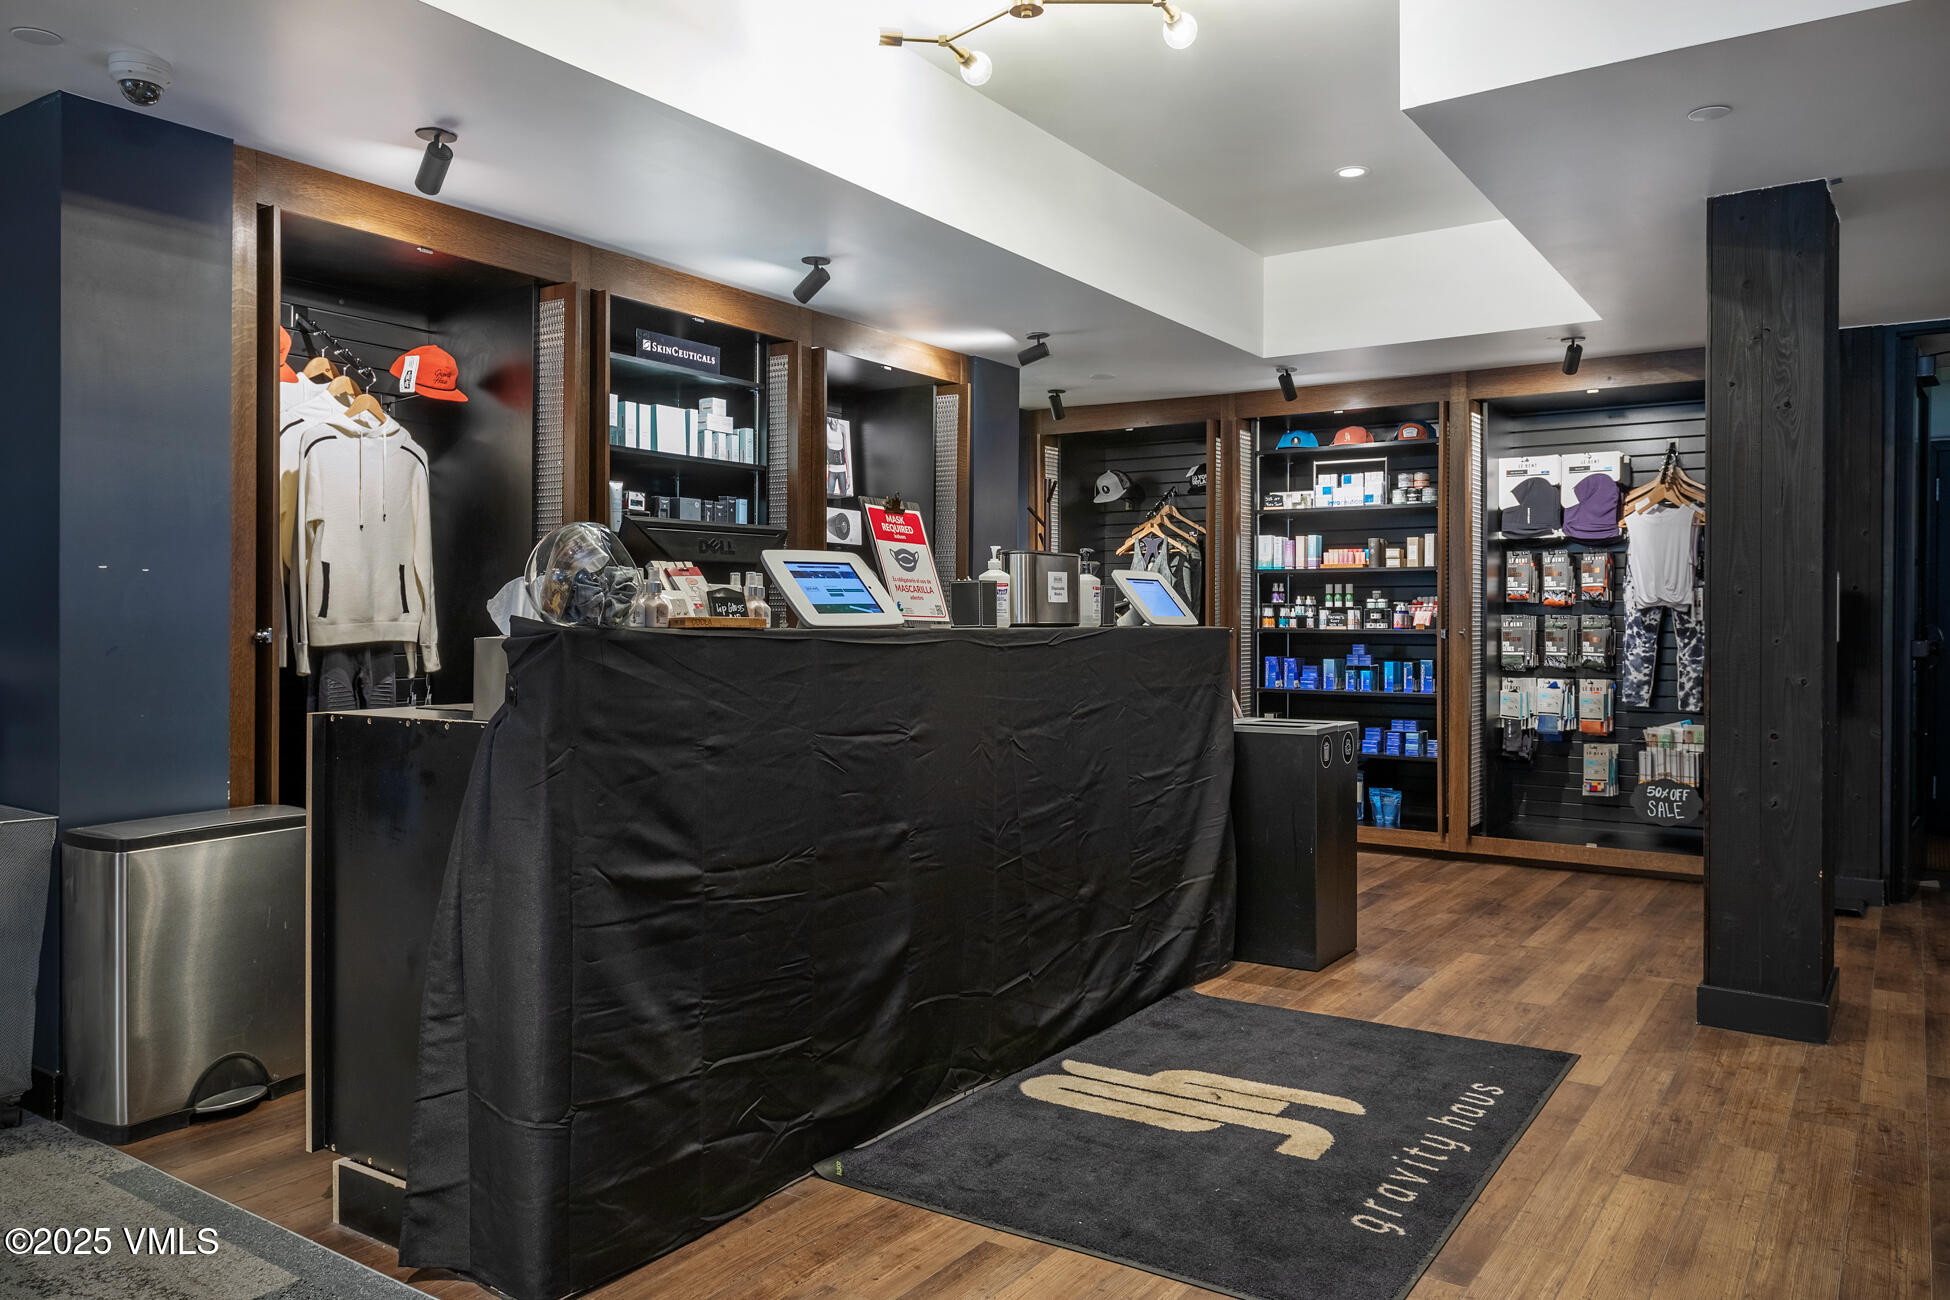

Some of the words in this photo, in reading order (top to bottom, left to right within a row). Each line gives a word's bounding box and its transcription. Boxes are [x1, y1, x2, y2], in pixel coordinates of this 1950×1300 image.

[884, 514, 906, 525] MASK
[881, 522, 914, 535] REQUIRED
[698, 537, 736, 555] DELL
[894, 584, 935, 594] MASCARILLA
[1646, 786, 1669, 799] 50%
[1670, 788, 1691, 802] OFF
[1647, 800, 1686, 819] SALE
[1351, 1133, 1472, 1235] gravity
[1426, 1082, 1505, 1132] haus
